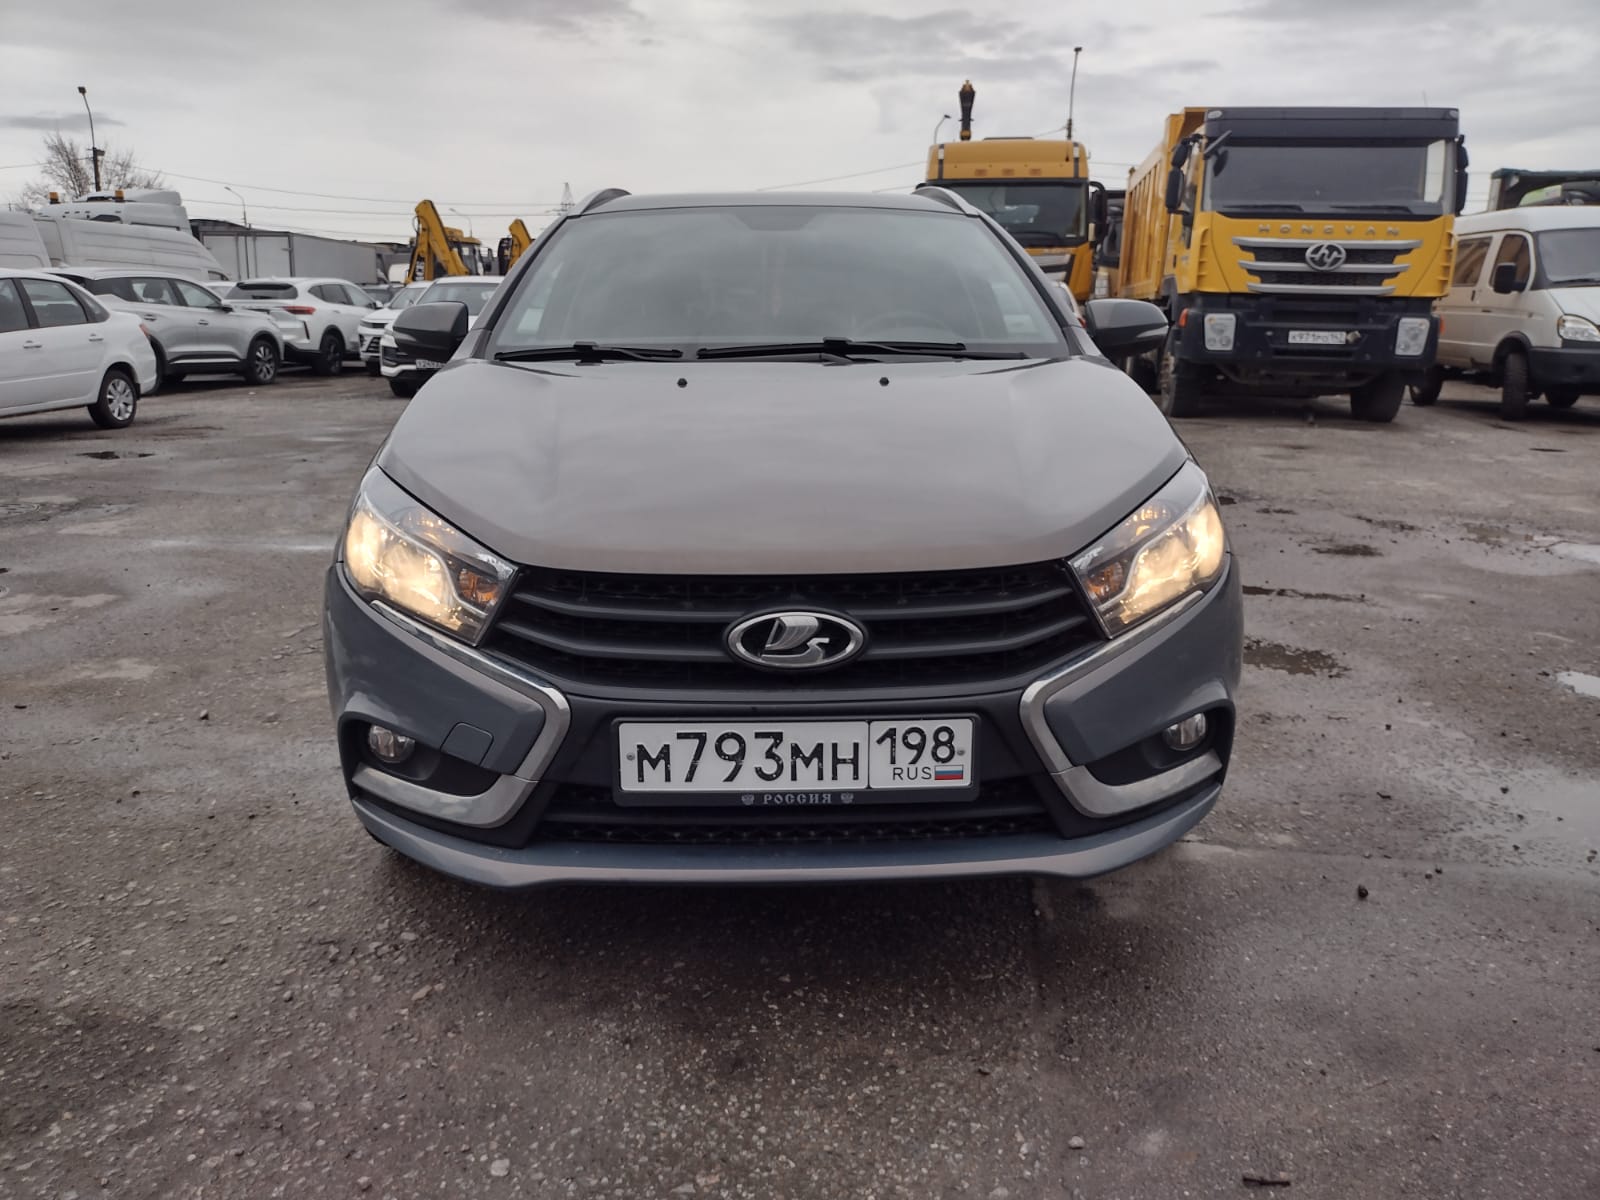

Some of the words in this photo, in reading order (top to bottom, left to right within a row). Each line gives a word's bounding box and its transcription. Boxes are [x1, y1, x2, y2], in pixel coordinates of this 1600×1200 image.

[1258, 223, 1400, 237] HONGYAN
[636, 731, 860, 783] М793МН
[876, 726, 956, 766] 198
[892, 766, 932, 781] RUS
[762, 793, 832, 805] РОССИЯ
